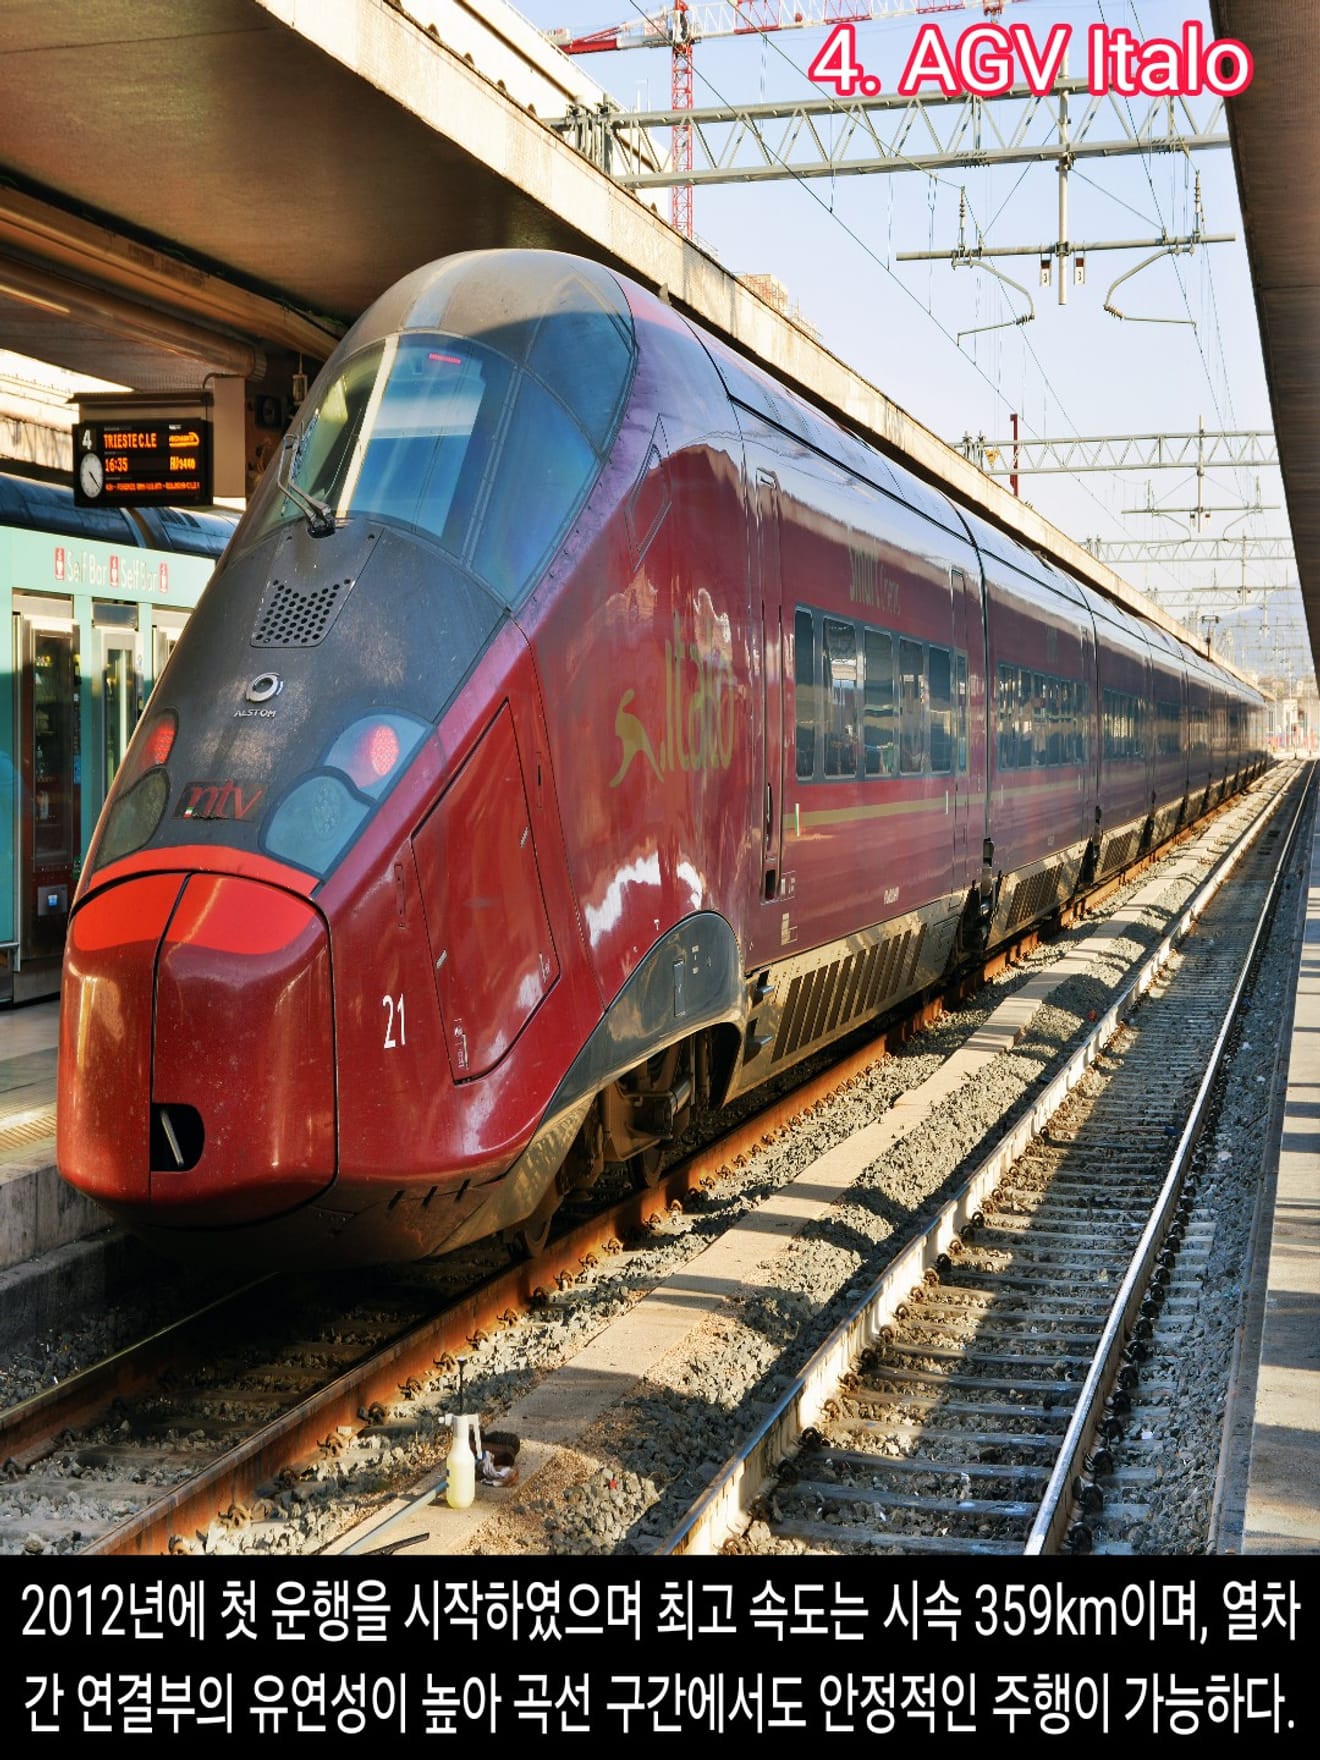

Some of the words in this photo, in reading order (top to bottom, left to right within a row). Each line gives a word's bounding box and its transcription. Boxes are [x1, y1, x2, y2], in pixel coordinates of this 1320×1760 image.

[82, 429, 92, 450] 4
[103, 433, 137, 449] TRIESTE
[105, 457, 128, 472] 16:35
[89, 553, 108, 586] Bar
[121, 559, 139, 590] Self
[233, 708, 277, 718] ALSTOM
[187, 780, 267, 820] ntv
[382, 993, 406, 1049] 21
